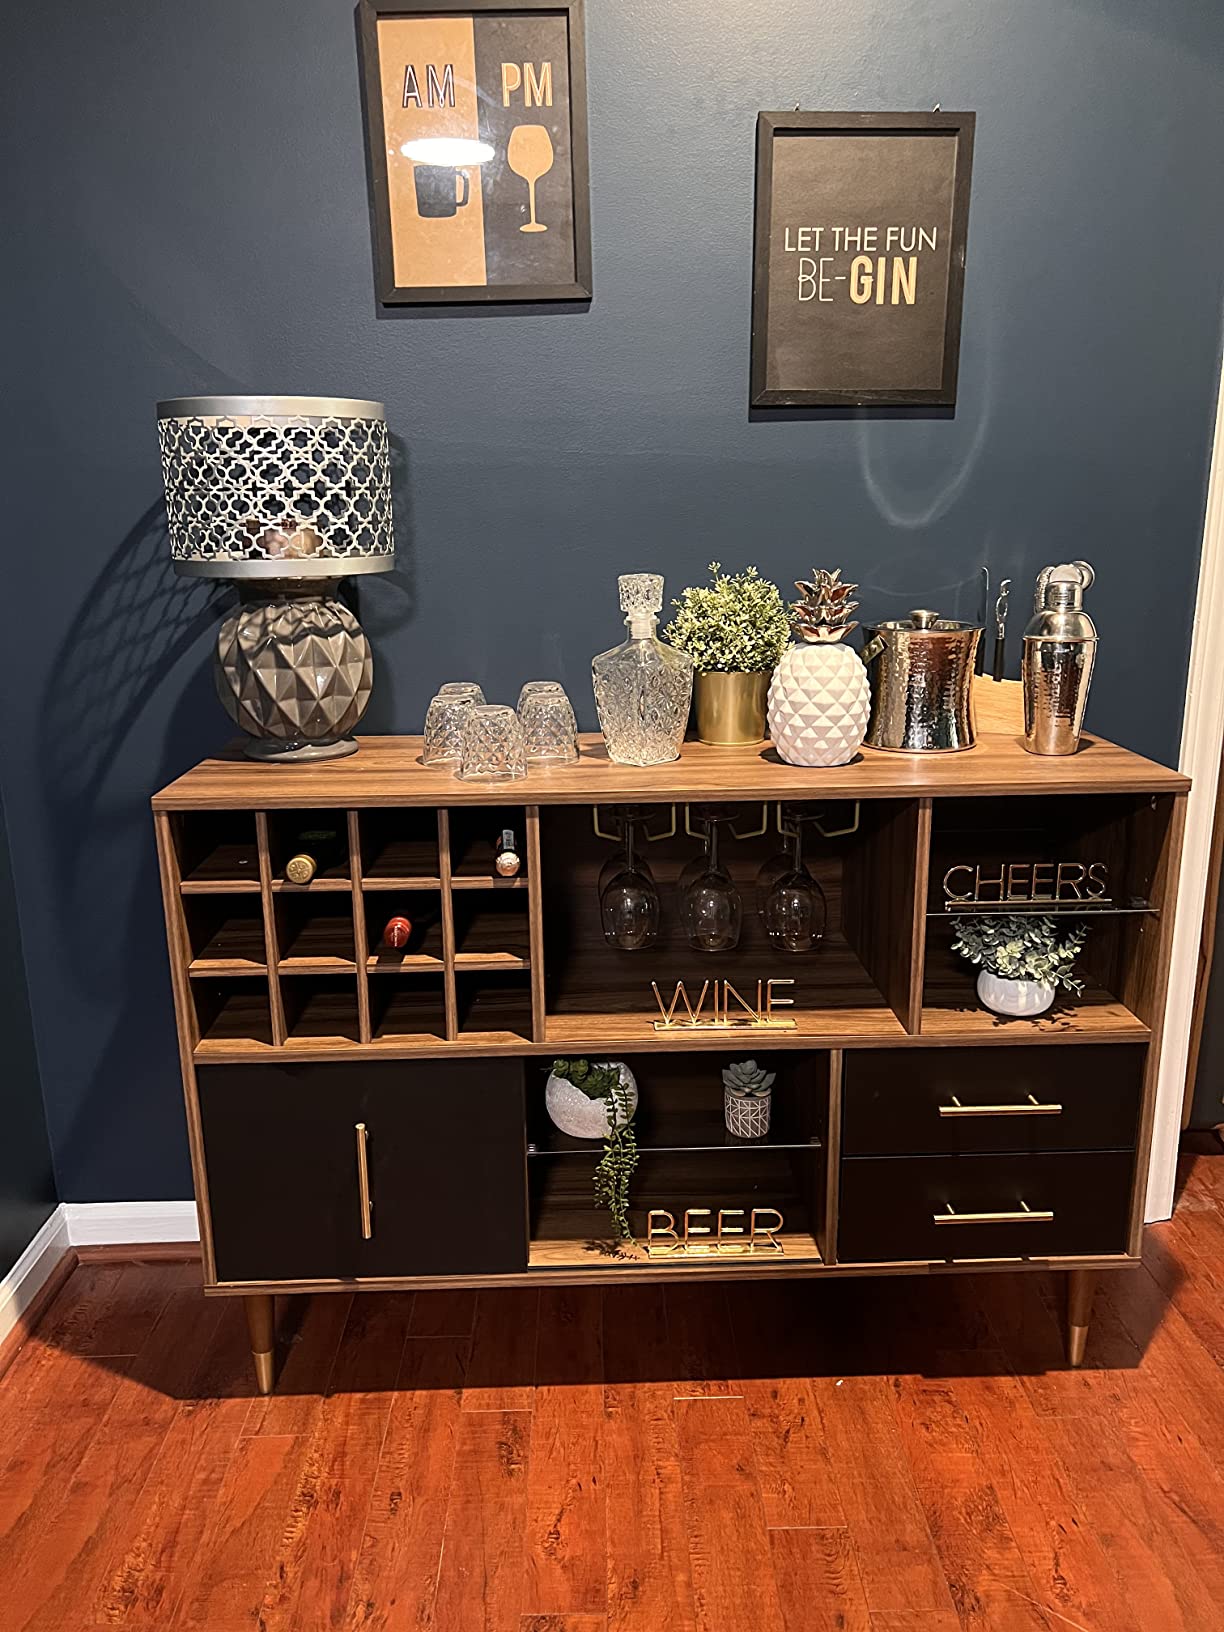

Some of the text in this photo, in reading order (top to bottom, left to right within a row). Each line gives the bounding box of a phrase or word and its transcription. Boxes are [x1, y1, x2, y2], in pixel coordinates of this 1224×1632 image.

[402, 62, 553, 108] AM PM
[784, 227, 937, 252] LET THE FUN
[798, 255, 918, 305] BE-GIN
[943, 862, 1109, 901] CHEERS
[651, 979, 795, 1026] WINE
[647, 1208, 784, 1256] BEER
